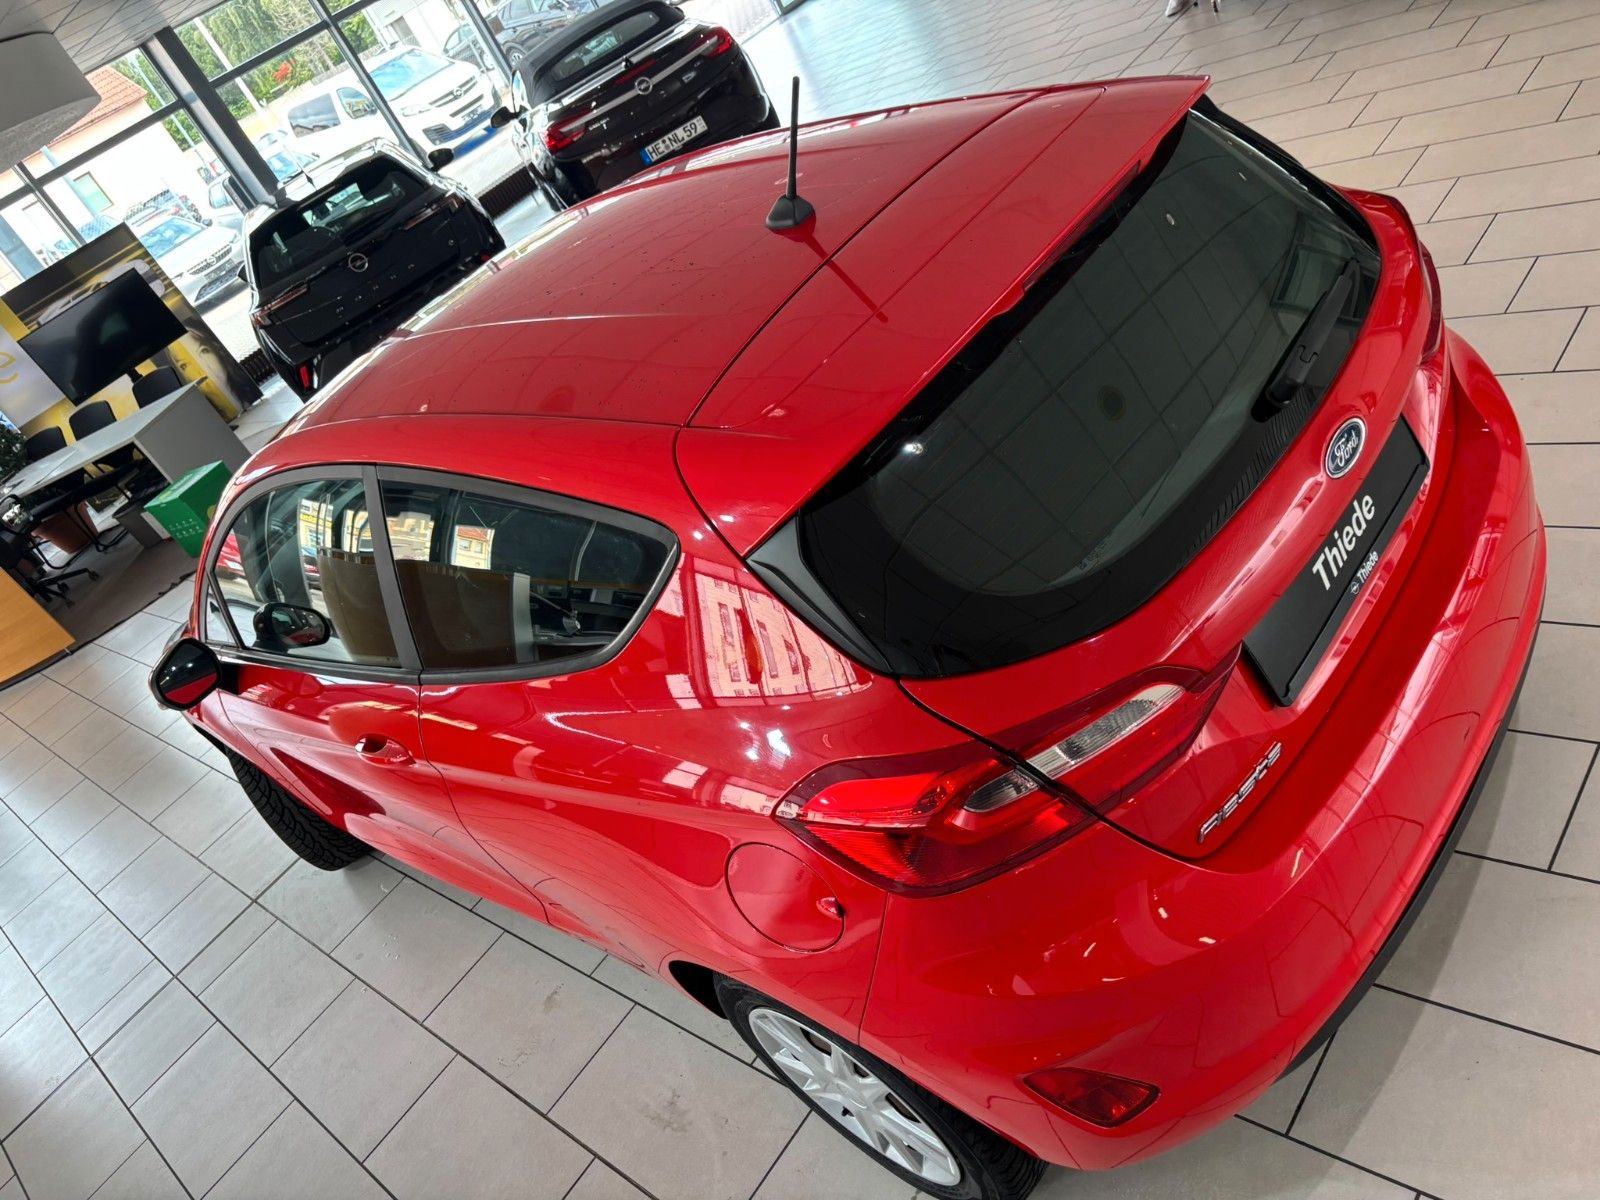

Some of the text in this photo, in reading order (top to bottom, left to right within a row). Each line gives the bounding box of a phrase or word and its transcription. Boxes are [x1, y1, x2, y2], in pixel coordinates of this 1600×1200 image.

[648, 142, 665, 160] HE
[667, 132, 685, 147] NL
[682, 122, 698, 138] 59
[1334, 430, 1359, 467] Ford
[1312, 494, 1375, 591] Thiede
[1357, 551, 1378, 584] Thiede
